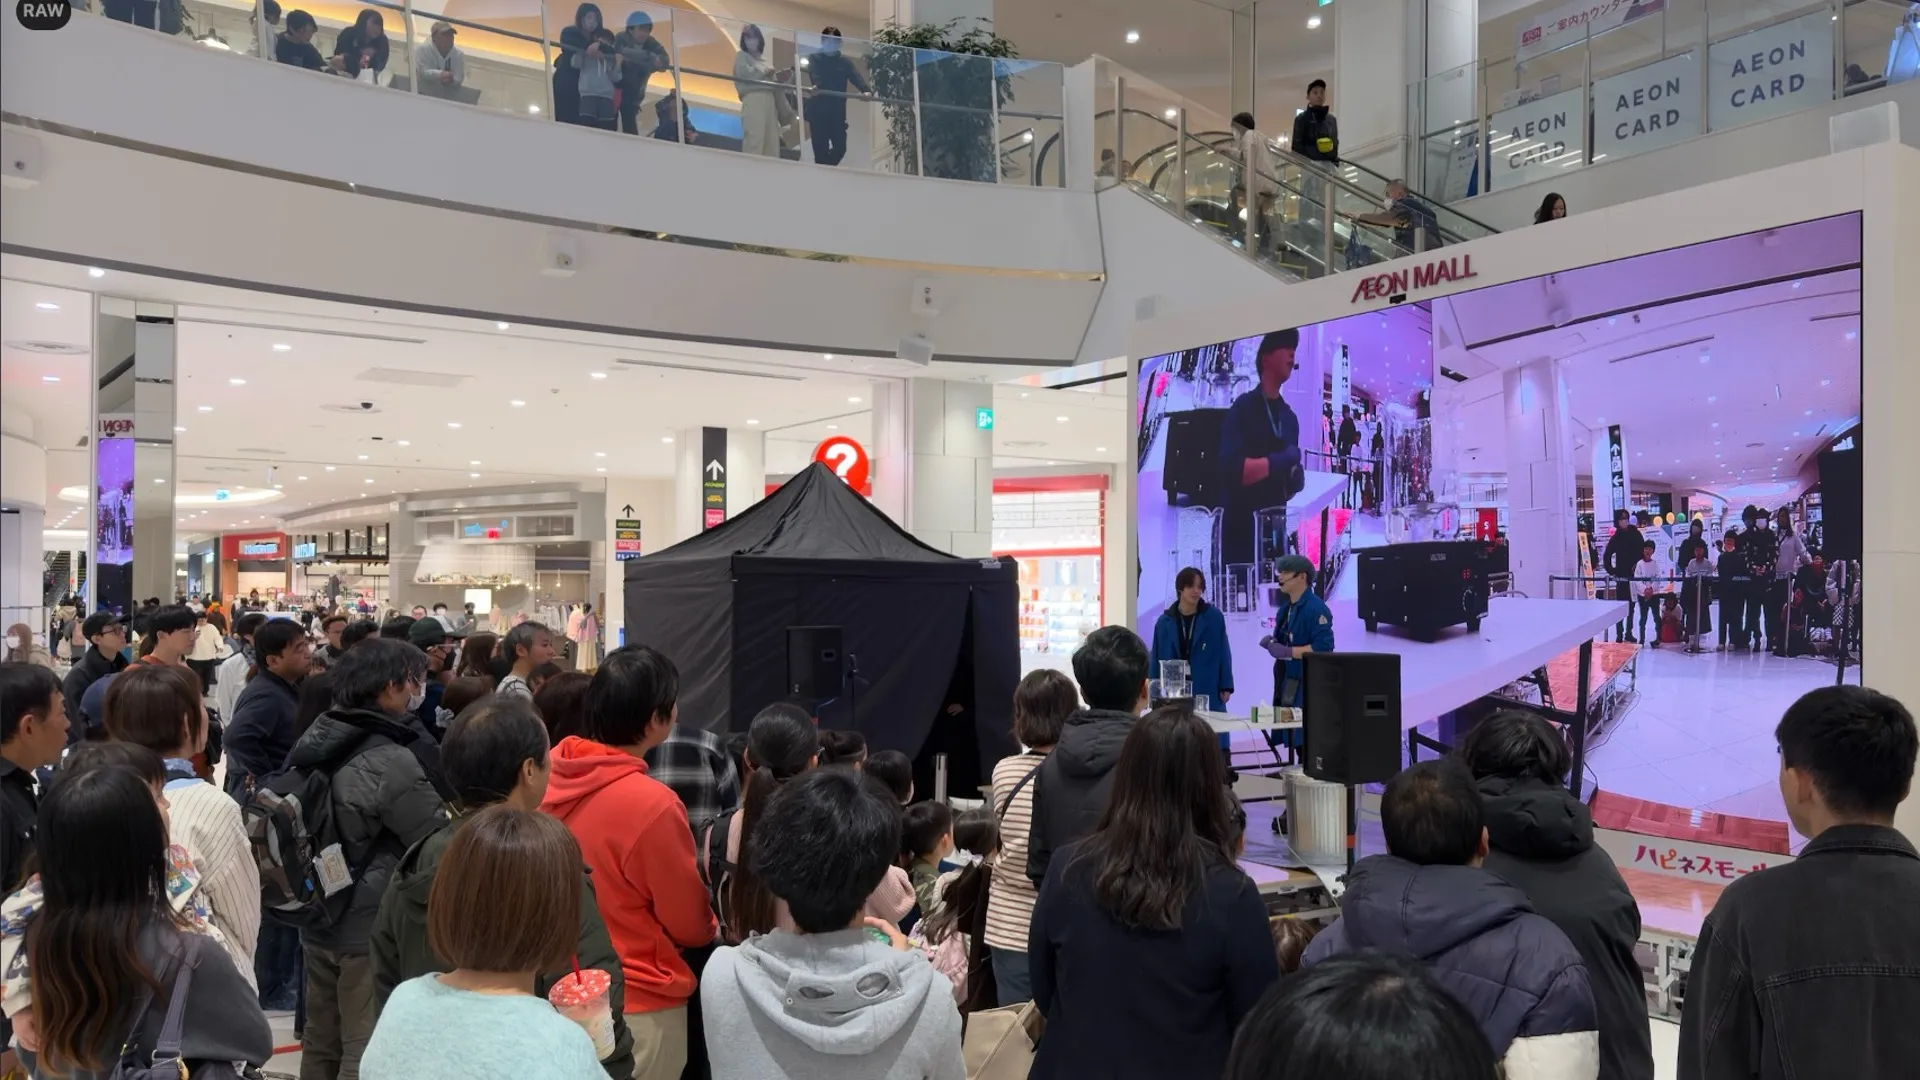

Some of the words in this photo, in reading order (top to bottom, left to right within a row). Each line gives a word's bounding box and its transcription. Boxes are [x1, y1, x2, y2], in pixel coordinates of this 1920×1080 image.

[1731, 40, 1805, 78] AEON
[1615, 78, 1680, 112] AEON
[1730, 74, 1805, 108] CARD
[1510, 112, 1566, 143] AEON
[1614, 109, 1680, 140] CARD
[1509, 141, 1566, 170] CARD
[1414, 254, 1478, 289] MALL
